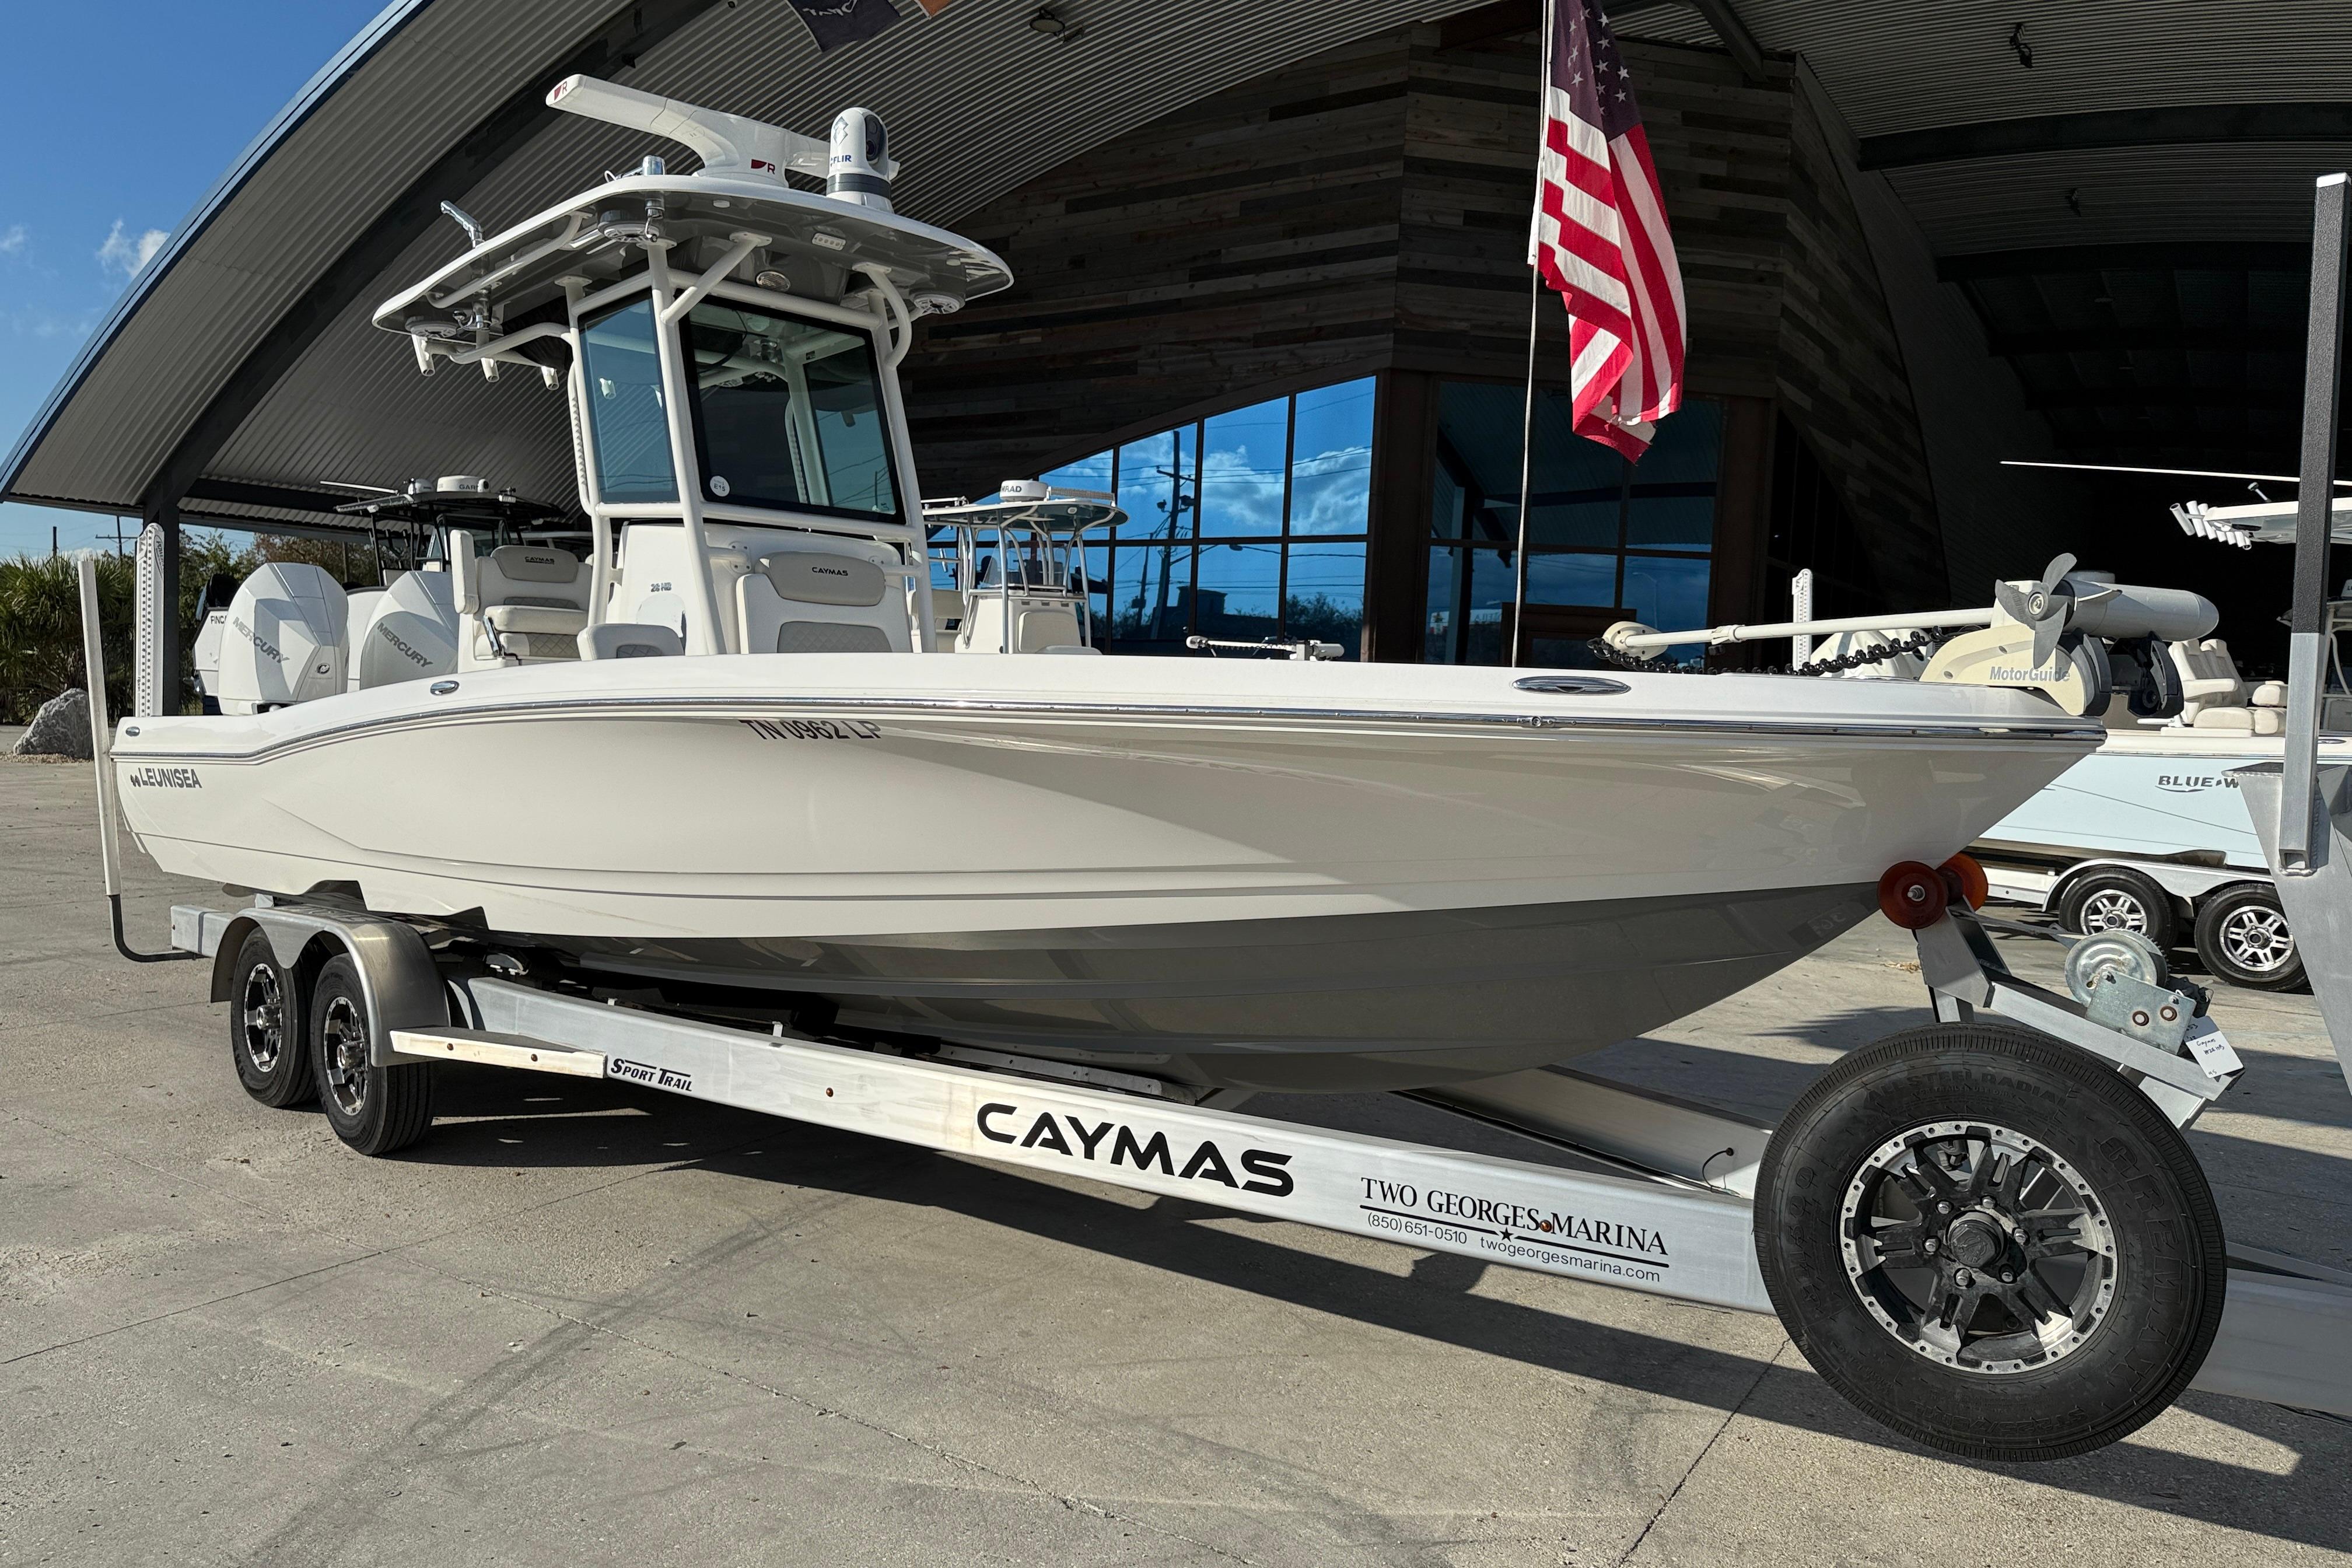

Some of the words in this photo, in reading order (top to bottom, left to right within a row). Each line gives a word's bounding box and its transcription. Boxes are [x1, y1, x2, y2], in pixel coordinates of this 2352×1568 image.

[833, 155, 852, 164] FLIR
[524, 556, 555, 565] CAYMAS
[811, 566, 849, 576] CAYMAS
[210, 615, 228, 624] FINC
[233, 616, 290, 663] MERCURY
[377, 622, 433, 667] MERCURY
[1989, 666, 2071, 682] MotorGuide
[738, 719, 788, 740] TN
[779, 719, 850, 740] 0962
[840, 719, 882, 739] LP
[138, 767, 203, 789] LEUNISEA
[2158, 775, 2215, 788] BLUE
[611, 1058, 657, 1083] SPORT
[657, 1068, 693, 1092] TRAIL
[977, 1102, 1294, 1198] CAYMAS
[1360, 1177, 1418, 1208] TWO
[1427, 1189, 1541, 1231] GEORGES
[1550, 1212, 1670, 1256] MARINA
[1367, 1212, 1402, 1234] (850)
[1404, 1221, 1468, 1245] 651-0510
[1480, 1236, 1661, 1283] twogeorgesmarina.com
